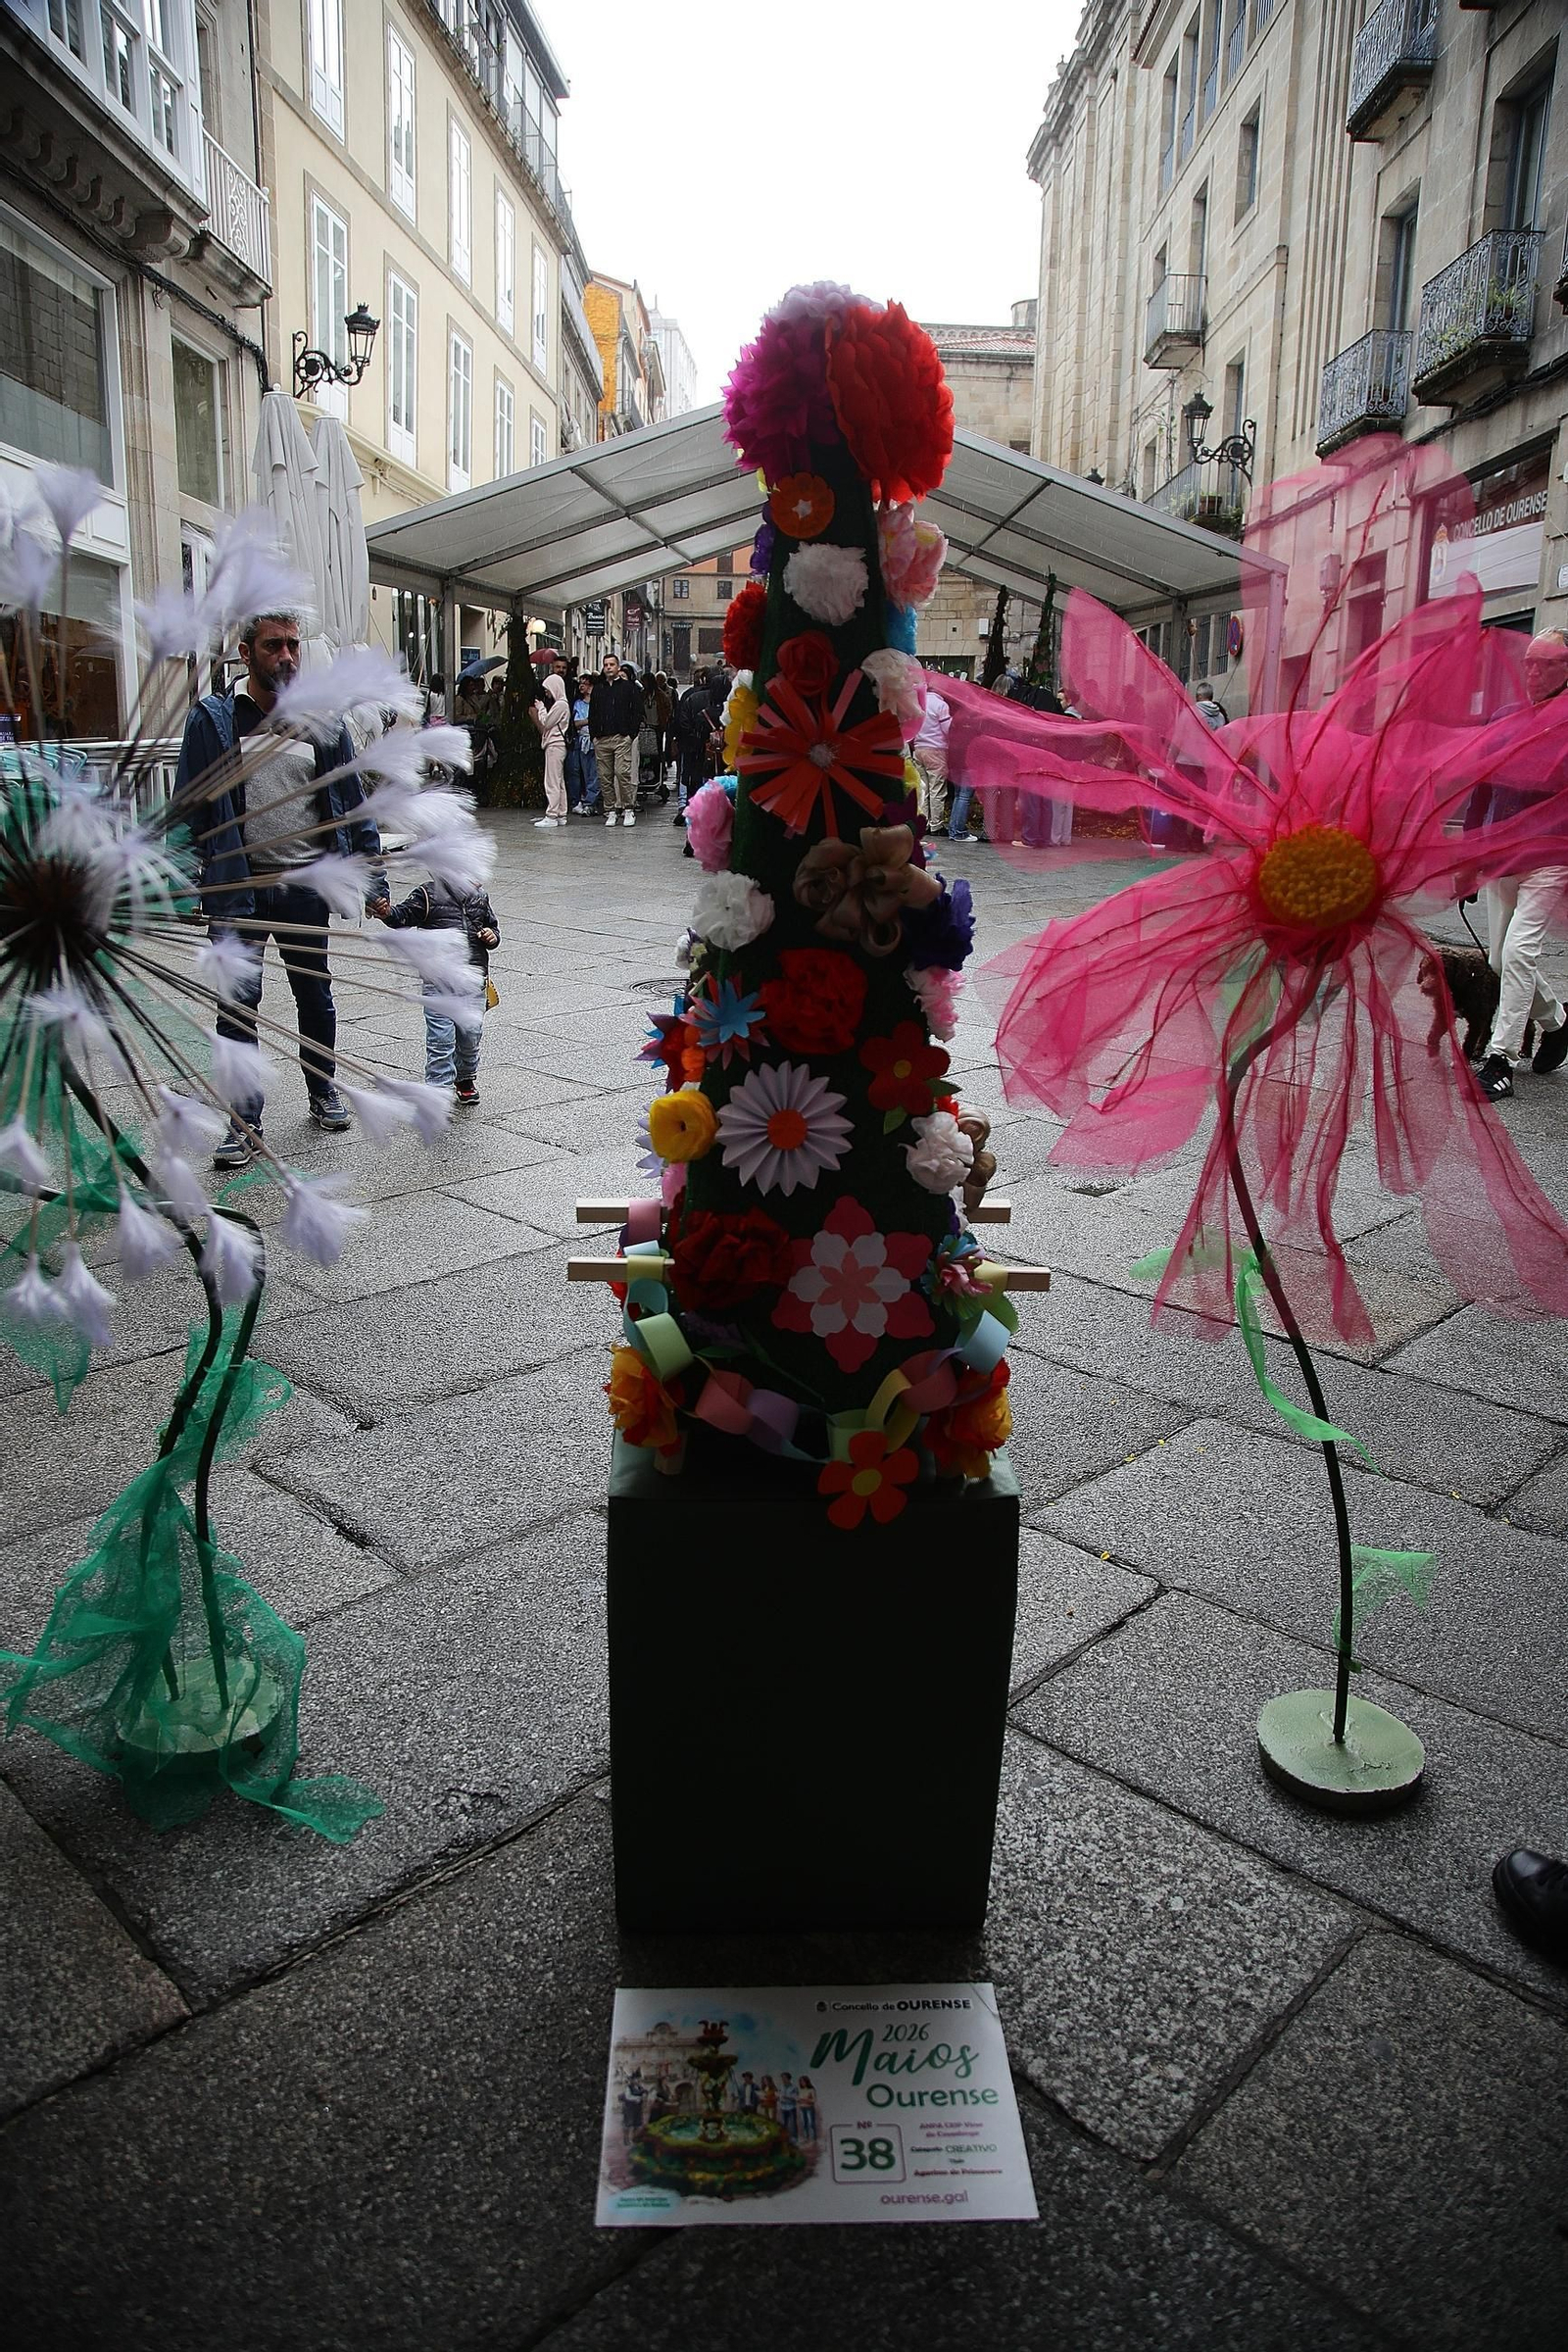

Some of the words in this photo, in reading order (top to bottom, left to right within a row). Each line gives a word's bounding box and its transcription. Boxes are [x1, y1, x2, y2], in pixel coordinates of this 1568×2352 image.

[1453, 512, 1494, 542] CONCELLO
[1494, 505, 1506, 527] DE
[1506, 490, 1548, 524] OURENSE
[832, 2001, 880, 2011] Concello
[882, 2001, 896, 2011] de
[896, 1999, 971, 2011] OURENSE
[882, 2022, 932, 2042] 2026
[809, 2028, 979, 2086] Maios
[865, 2082, 1000, 2108] Ourense
[840, 2136, 897, 2171] 38
[945, 2142, 998, 2155] CREATIVO
[880, 2189, 969, 2206] ourense.gal
